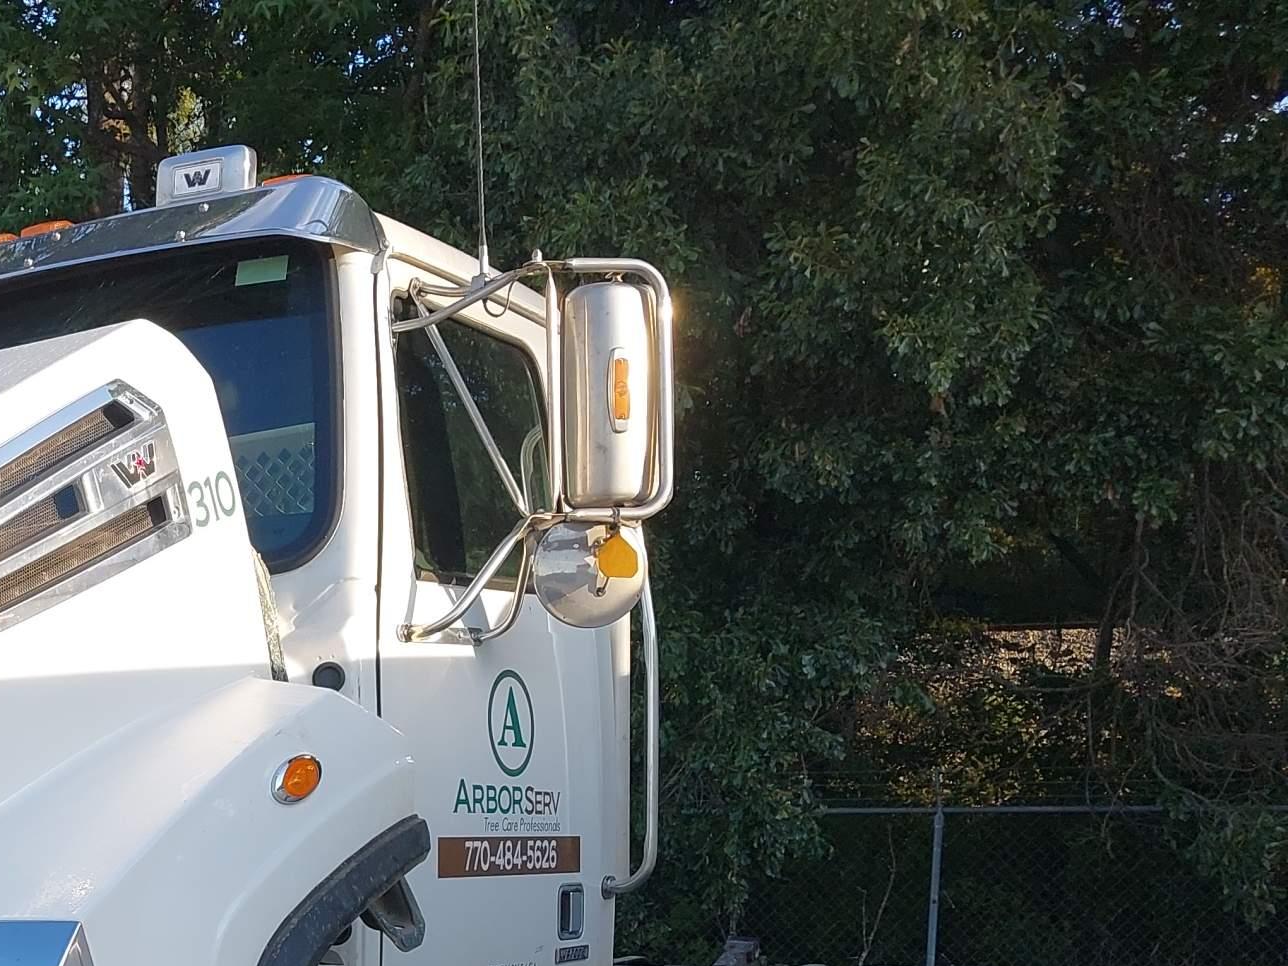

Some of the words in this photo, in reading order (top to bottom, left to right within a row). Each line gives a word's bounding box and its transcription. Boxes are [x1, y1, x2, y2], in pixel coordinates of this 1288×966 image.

[187, 470, 236, 527] 310
[497, 685, 527, 748] A
[483, 817, 499, 832] Tree
[501, 817, 519, 832] Care
[519, 817, 561, 832] Professionals
[464, 839, 557, 872] 770-484-5626
